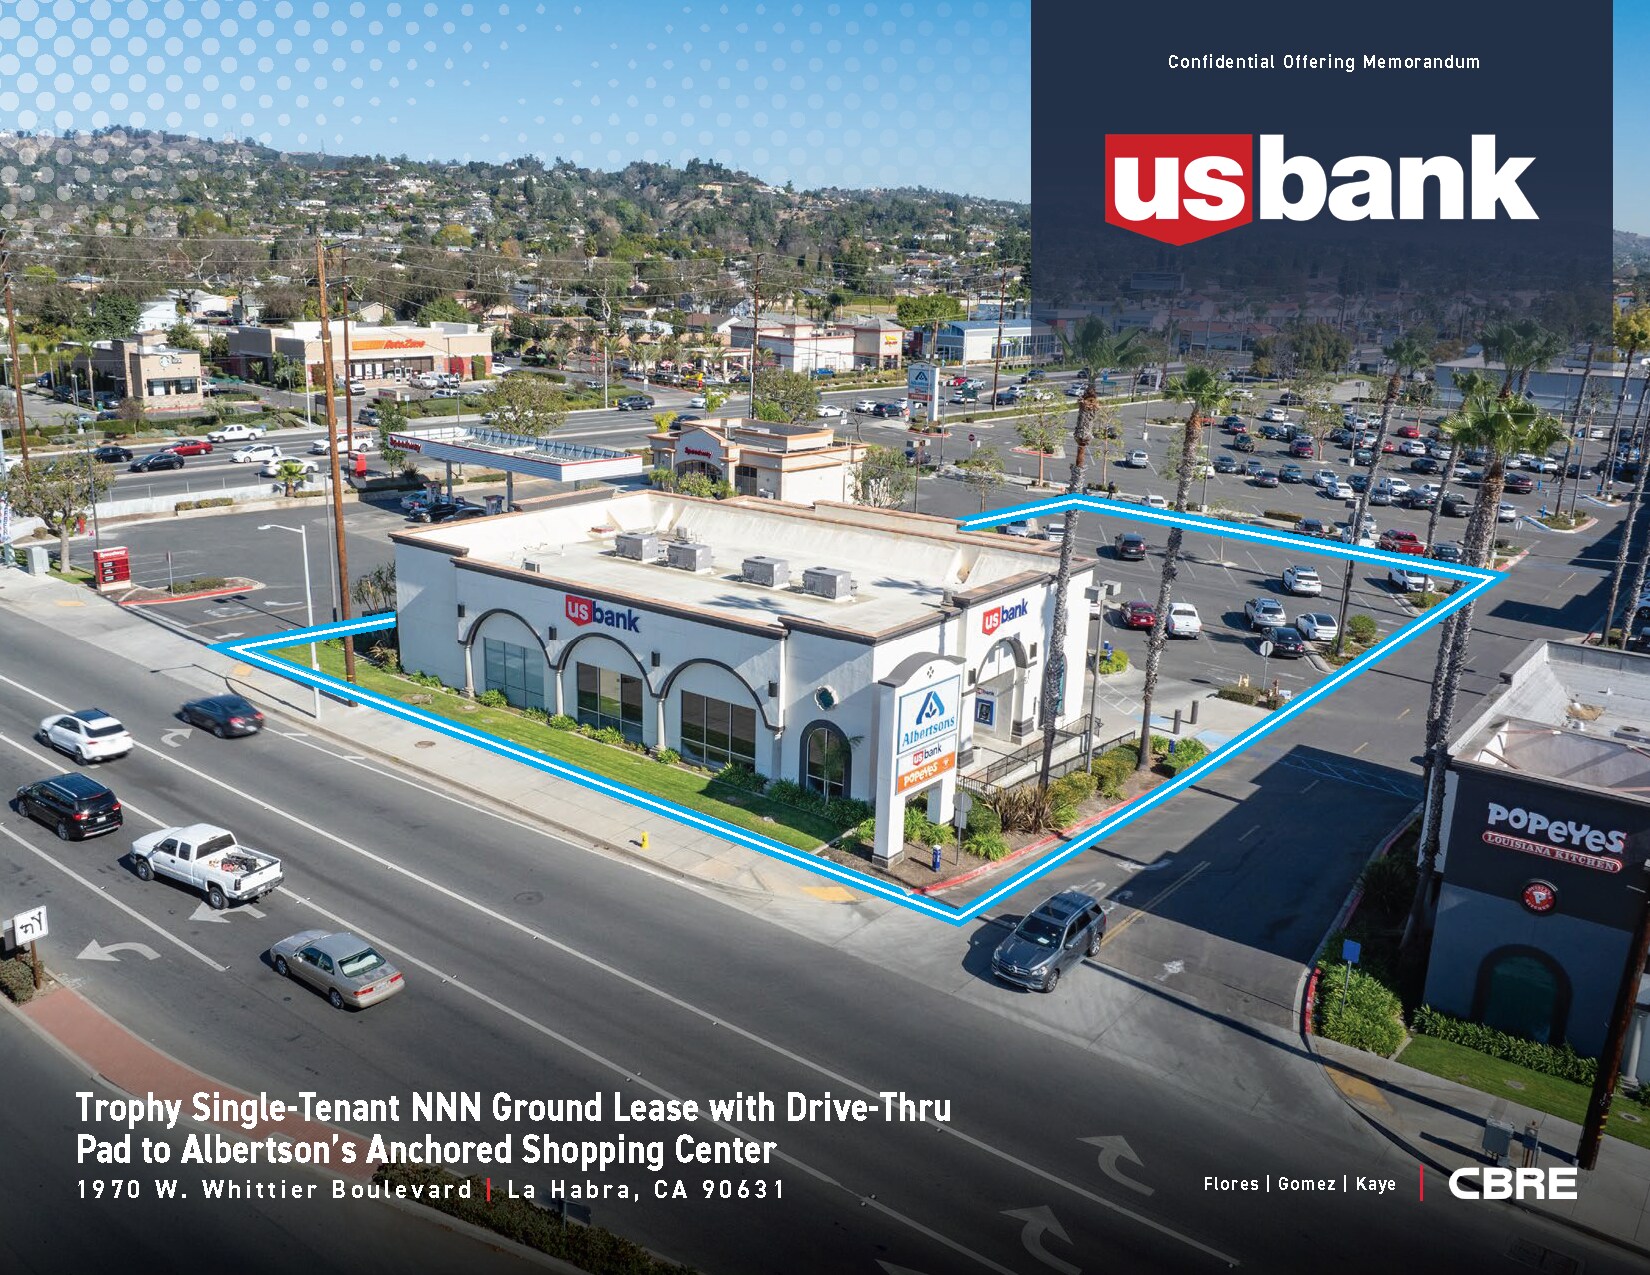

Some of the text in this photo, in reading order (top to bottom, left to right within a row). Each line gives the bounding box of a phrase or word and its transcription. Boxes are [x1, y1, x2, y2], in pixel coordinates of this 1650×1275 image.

[902, 716, 955, 747] Albertsons
[1487, 834, 1615, 871] LOUISIANA KITCHEN
